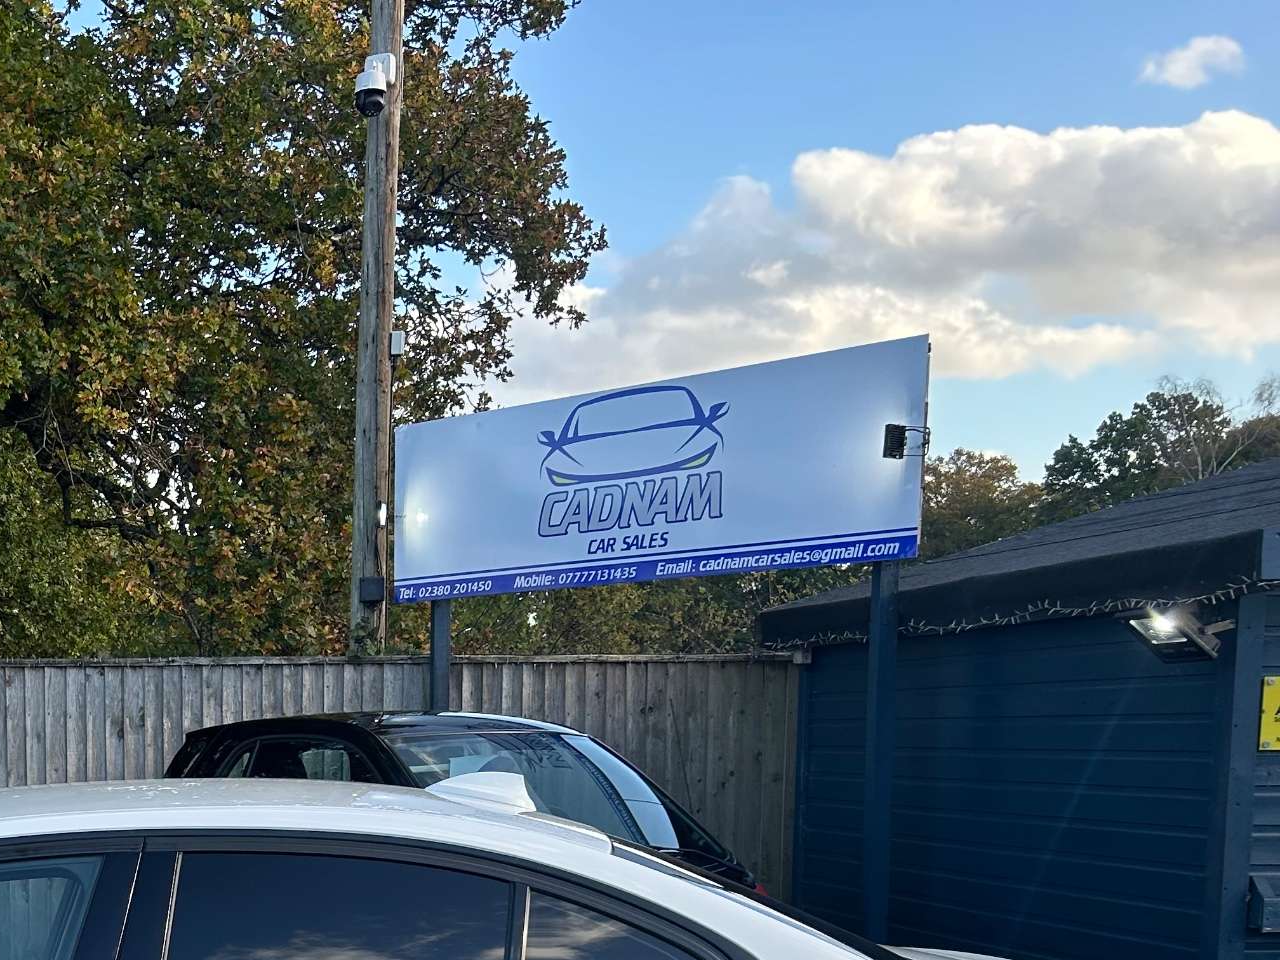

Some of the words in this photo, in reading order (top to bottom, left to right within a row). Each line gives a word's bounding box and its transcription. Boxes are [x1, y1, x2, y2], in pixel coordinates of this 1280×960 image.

[538, 471, 723, 537] CADNAM
[587, 537, 617, 555] CAR
[620, 532, 669, 551] SALES
[399, 587, 417, 599] Tel:
[418, 584, 451, 598] 02380
[453, 580, 492, 595] 201450
[514, 575, 556, 589] Mobile:
[558, 566, 637, 585] 07777131435
[655, 561, 696, 576] Email:
